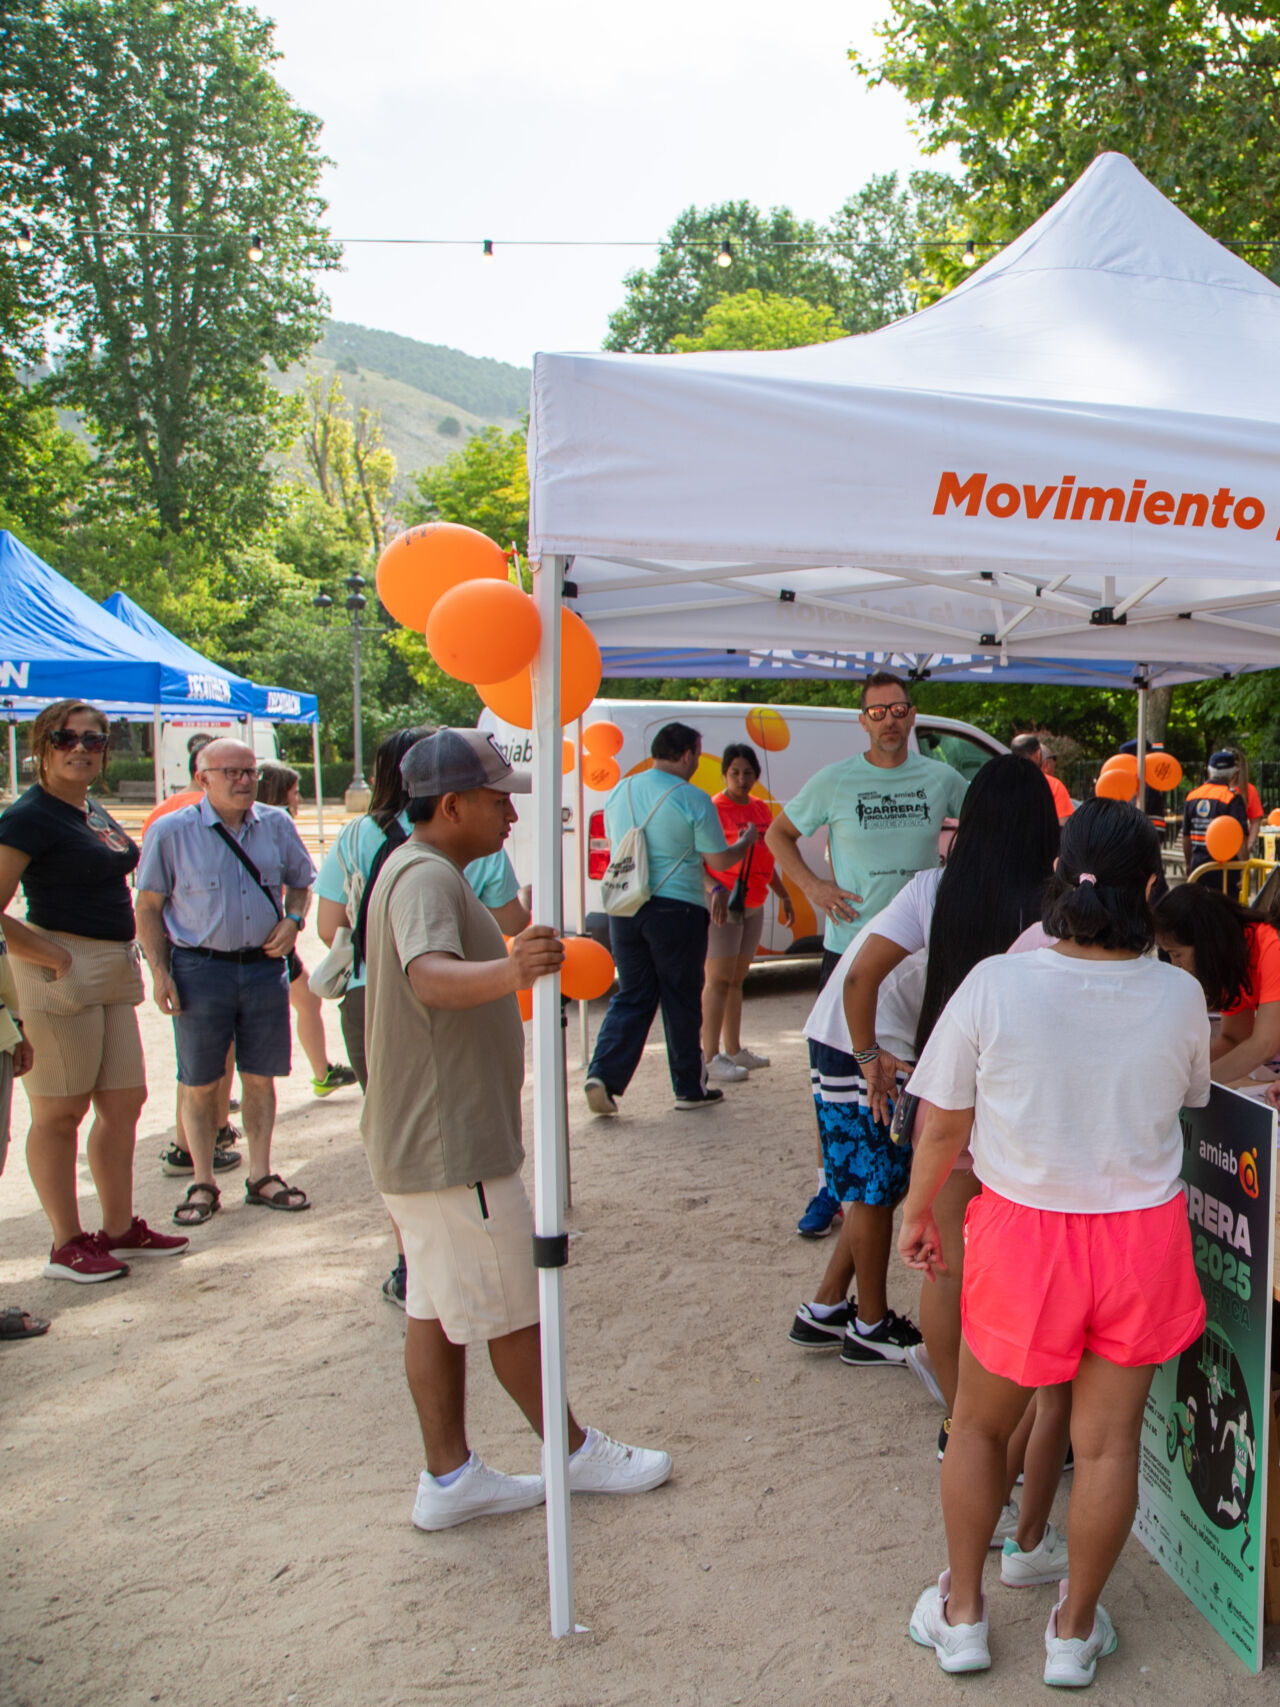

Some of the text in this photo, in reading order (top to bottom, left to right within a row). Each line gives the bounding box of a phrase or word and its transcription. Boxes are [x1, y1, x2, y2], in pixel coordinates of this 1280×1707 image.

[932, 471, 1266, 530] Movimiento
[864, 804, 924, 814] CARRERA
[1199, 1139, 1238, 1176] amiab
[1195, 1234, 1252, 1301] 2025
